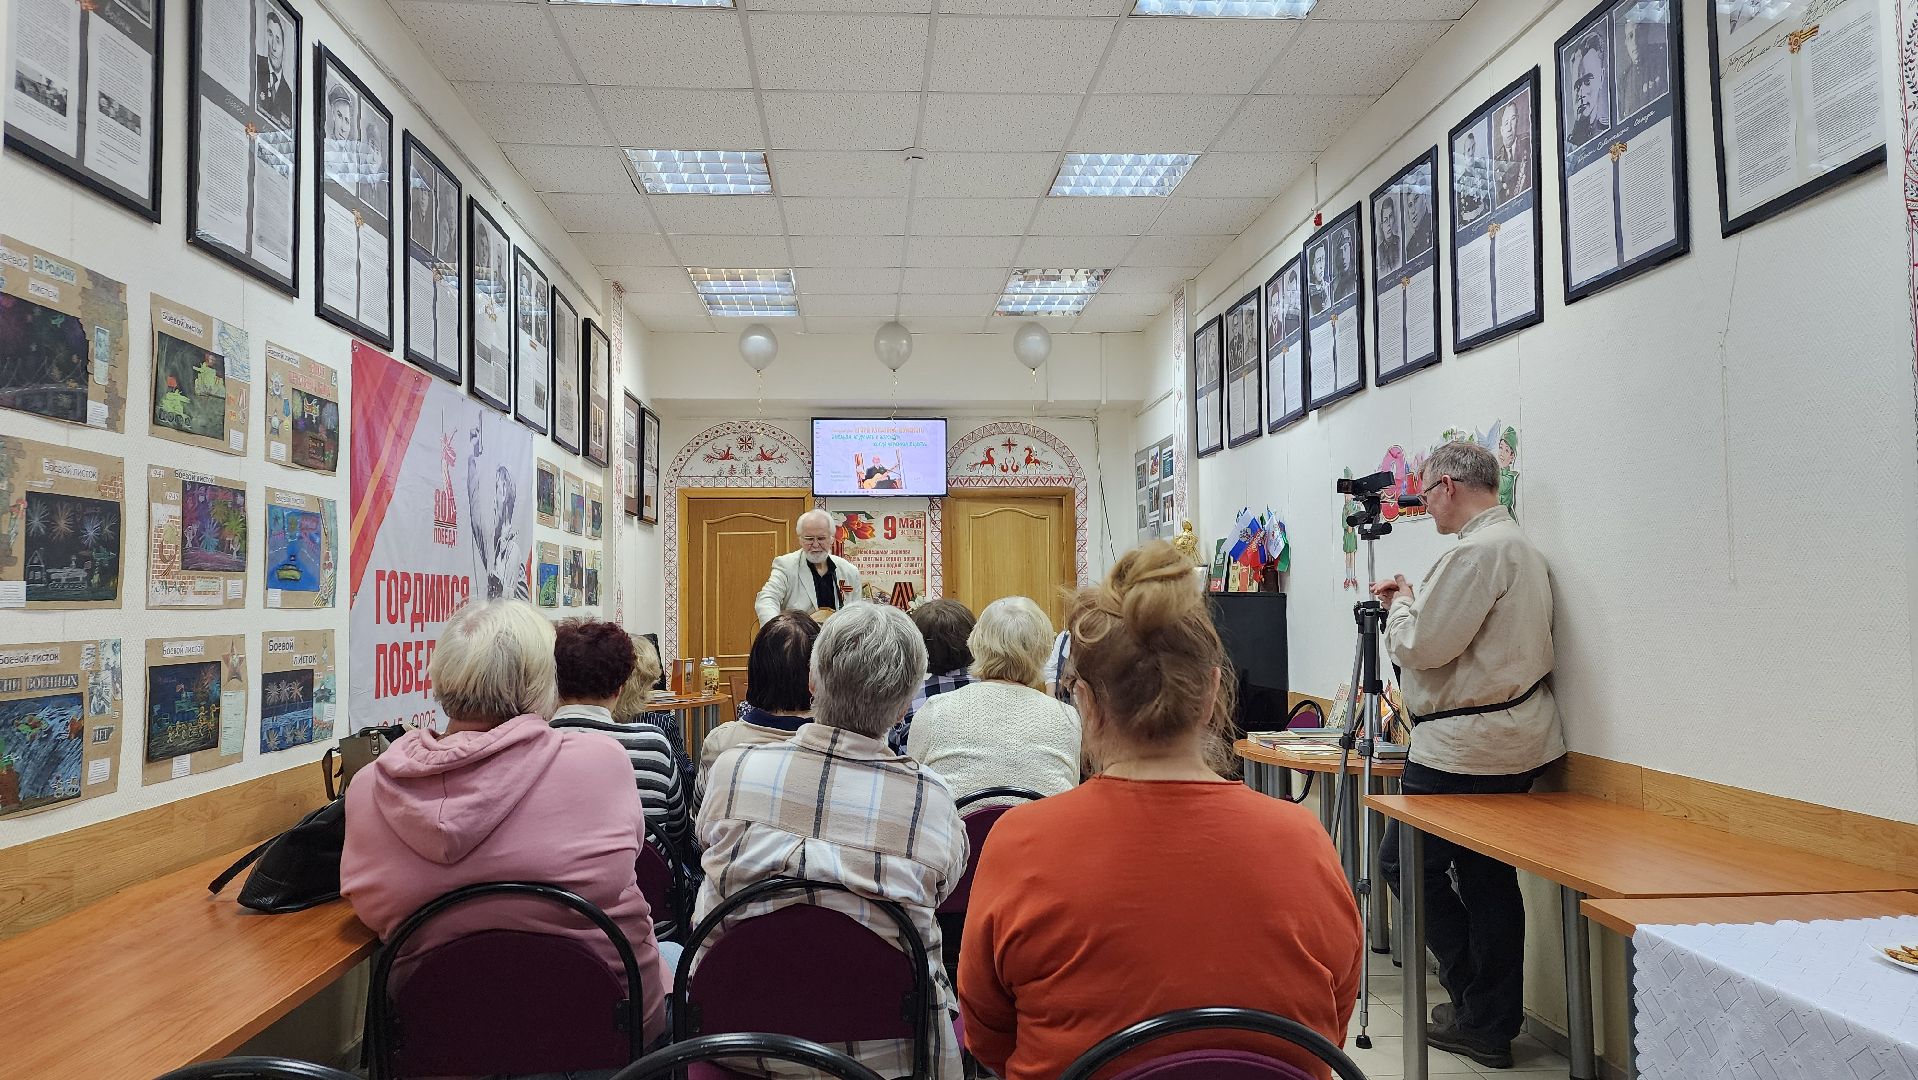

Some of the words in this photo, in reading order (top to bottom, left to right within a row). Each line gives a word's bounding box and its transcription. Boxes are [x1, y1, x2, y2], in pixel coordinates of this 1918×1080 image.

[884, 515, 896, 540] 9
[375, 569, 470, 633] ГОРДИМСЯ
[269, 638, 294, 651] Боевой
